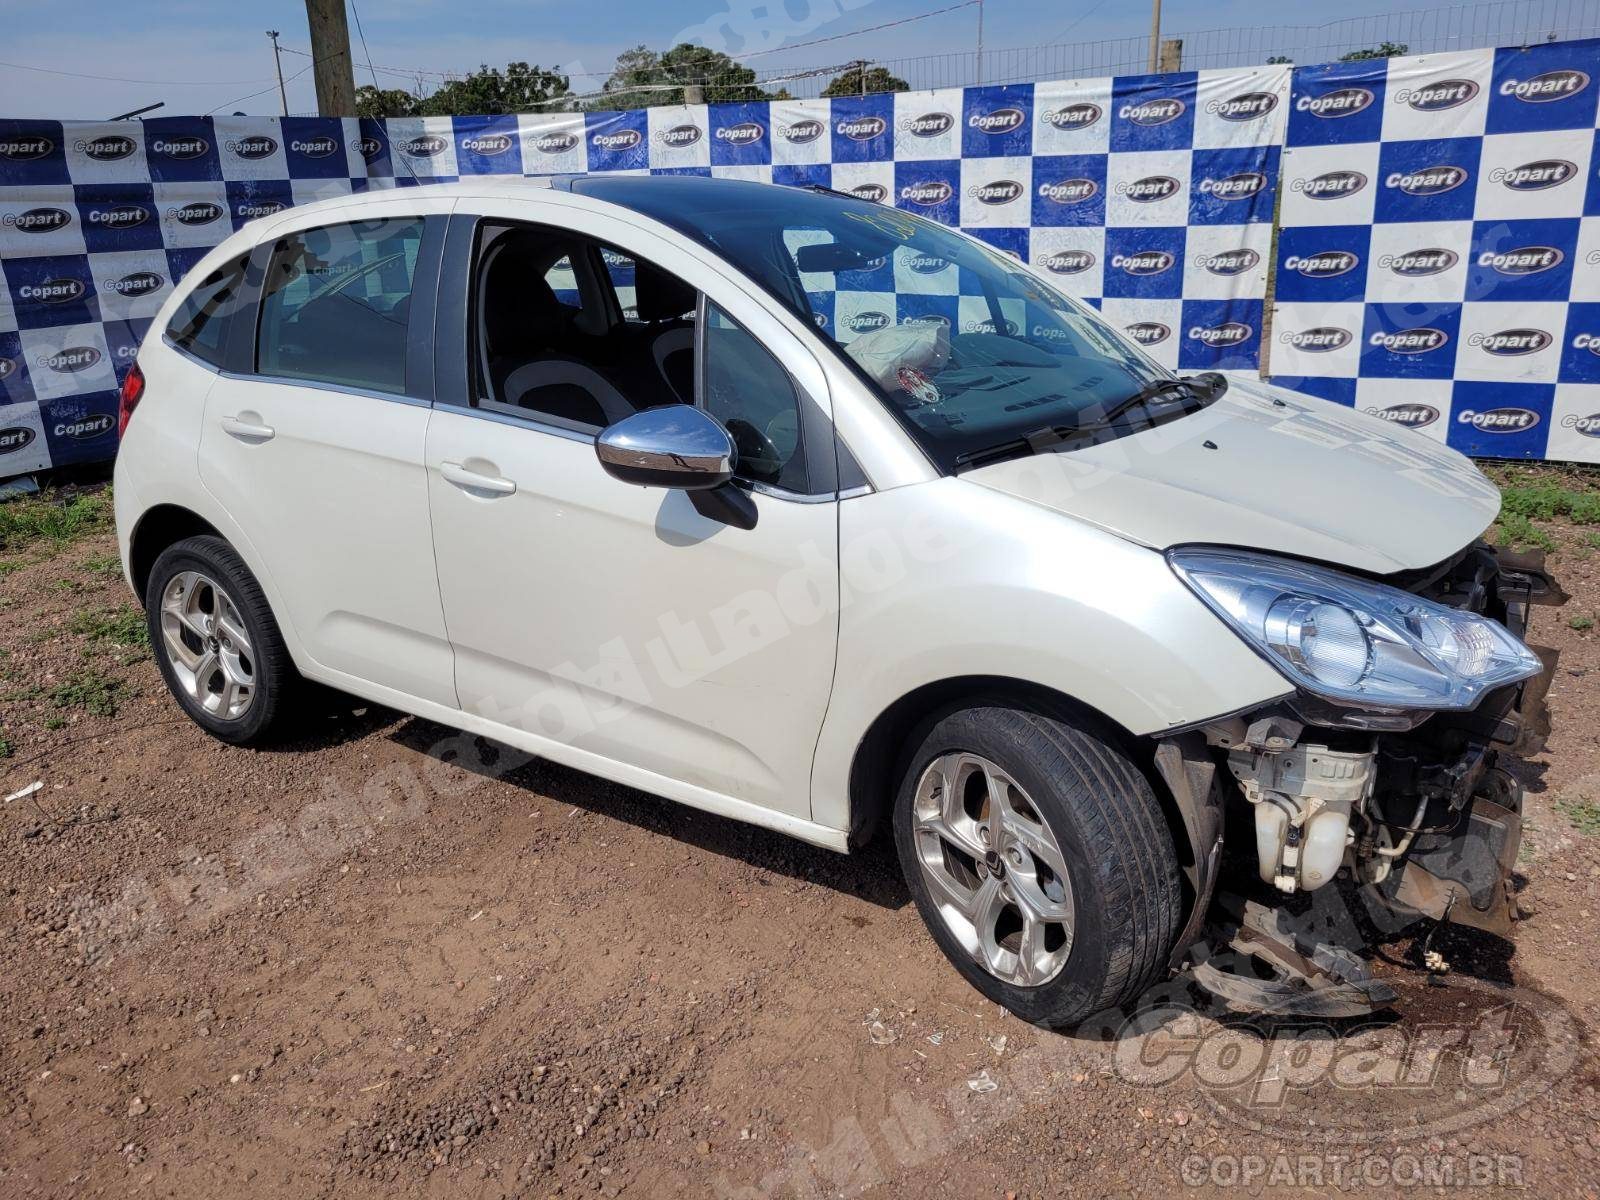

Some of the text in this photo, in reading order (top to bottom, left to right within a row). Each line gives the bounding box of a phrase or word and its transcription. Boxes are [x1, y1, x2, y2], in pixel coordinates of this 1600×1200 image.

[1394, 82, 1466, 107] Copart
[1500, 75, 1578, 97] Copart
[1206, 95, 1268, 116] Copart
[1296, 91, 1363, 114] Copart
[1042, 109, 1092, 124] Copart
[1119, 103, 1175, 121] Copart
[837, 121, 880, 136] Copart
[902, 116, 946, 132] Copart
[968, 113, 1017, 129] Copart
[592, 133, 636, 147] Copart
[655, 127, 697, 142] Copart
[716, 126, 757, 141] Copart
[777, 124, 818, 139] Copart
[0, 141, 45, 155] opart
[74, 141, 128, 156] Copart
[153, 141, 202, 155] Copart
[226, 140, 271, 154] Copart
[291, 141, 332, 154] Copart
[398, 139, 439, 153] Copart
[462, 138, 506, 150] Copart
[526, 135, 571, 150] Copart
[1386, 168, 1458, 192] Copart
[1488, 164, 1566, 186] Copart
[902, 184, 946, 198] Copart
[968, 184, 1015, 198] Copart
[1039, 182, 1090, 198] Copart
[1115, 179, 1170, 196] Copart
[1200, 175, 1260, 195] Copart
[1290, 174, 1356, 194] Copart
[3, 210, 62, 227] Copart
[89, 208, 142, 224] Copart
[167, 204, 216, 221] Copart
[901, 255, 943, 267] Copart
[1038, 254, 1087, 269] Copart
[1112, 254, 1167, 271] Copart
[1195, 252, 1253, 270] Copart
[1285, 255, 1348, 276] Copart
[1377, 253, 1447, 274] Copart
[1477, 250, 1552, 271] Copart
[20, 285, 77, 299] Copart
[104, 275, 158, 294] Copart
[841, 316, 883, 328] Copart
[1189, 325, 1244, 343] Copart
[1280, 331, 1343, 350] Copart
[1370, 331, 1438, 351] Copart
[1468, 333, 1543, 350] Copart
[36, 350, 92, 369] Copart
[54, 417, 109, 436] Copart
[1457, 410, 1531, 427] Copart
